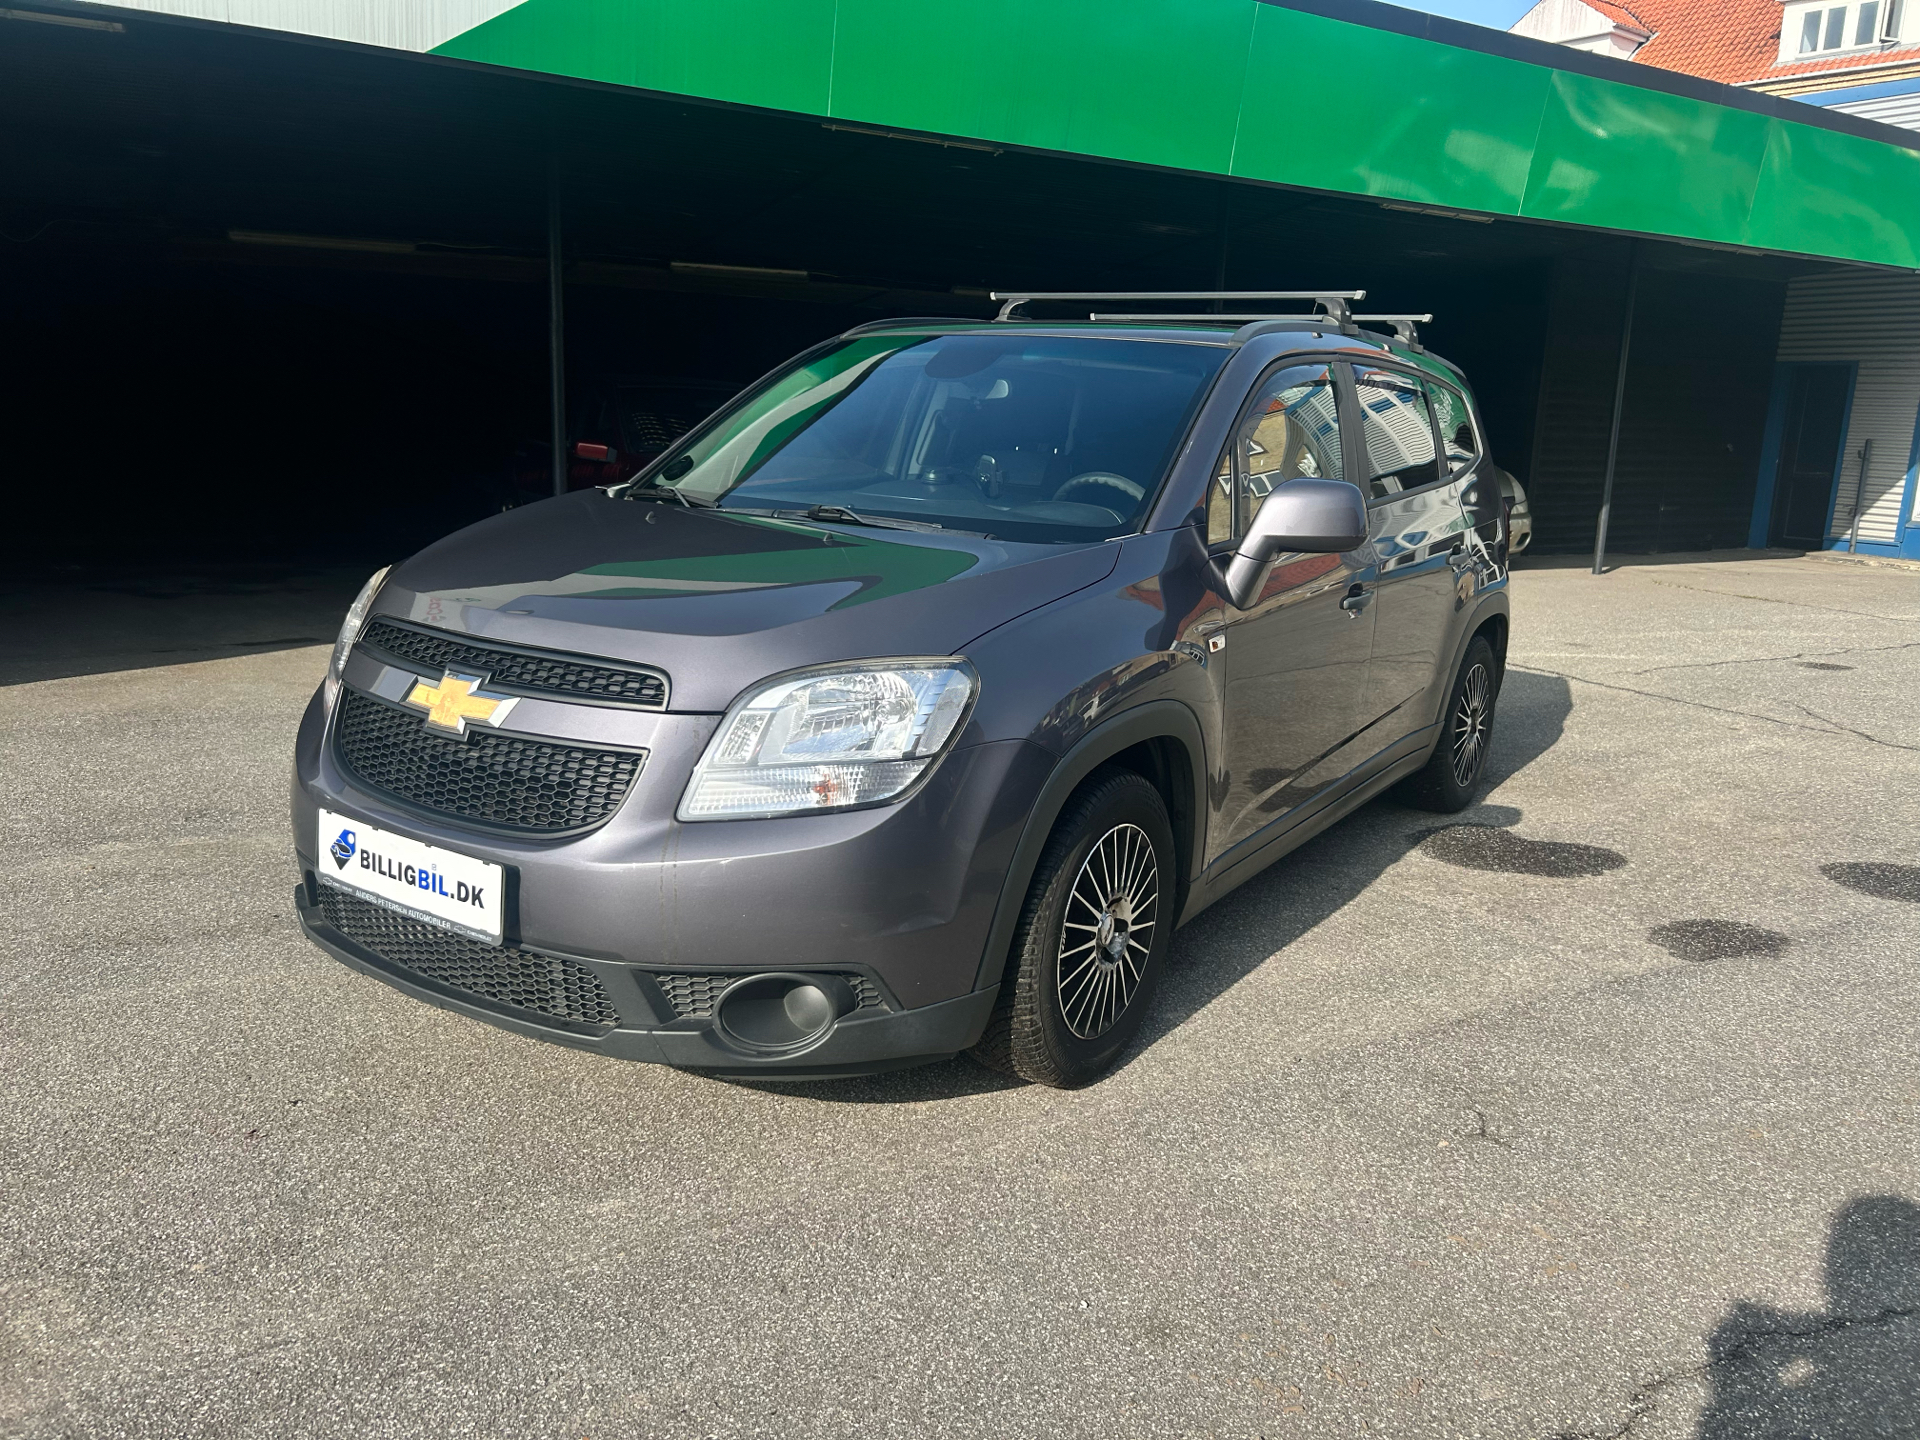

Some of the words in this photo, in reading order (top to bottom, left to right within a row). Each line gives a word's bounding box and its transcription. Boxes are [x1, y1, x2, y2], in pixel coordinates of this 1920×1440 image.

[361, 848, 485, 909] BILLIGBIL.DK
[355, 889, 377, 904] ANDERS
[378, 898, 407, 915] PETERSEN
[408, 909, 451, 929] AUTOMOBILER
